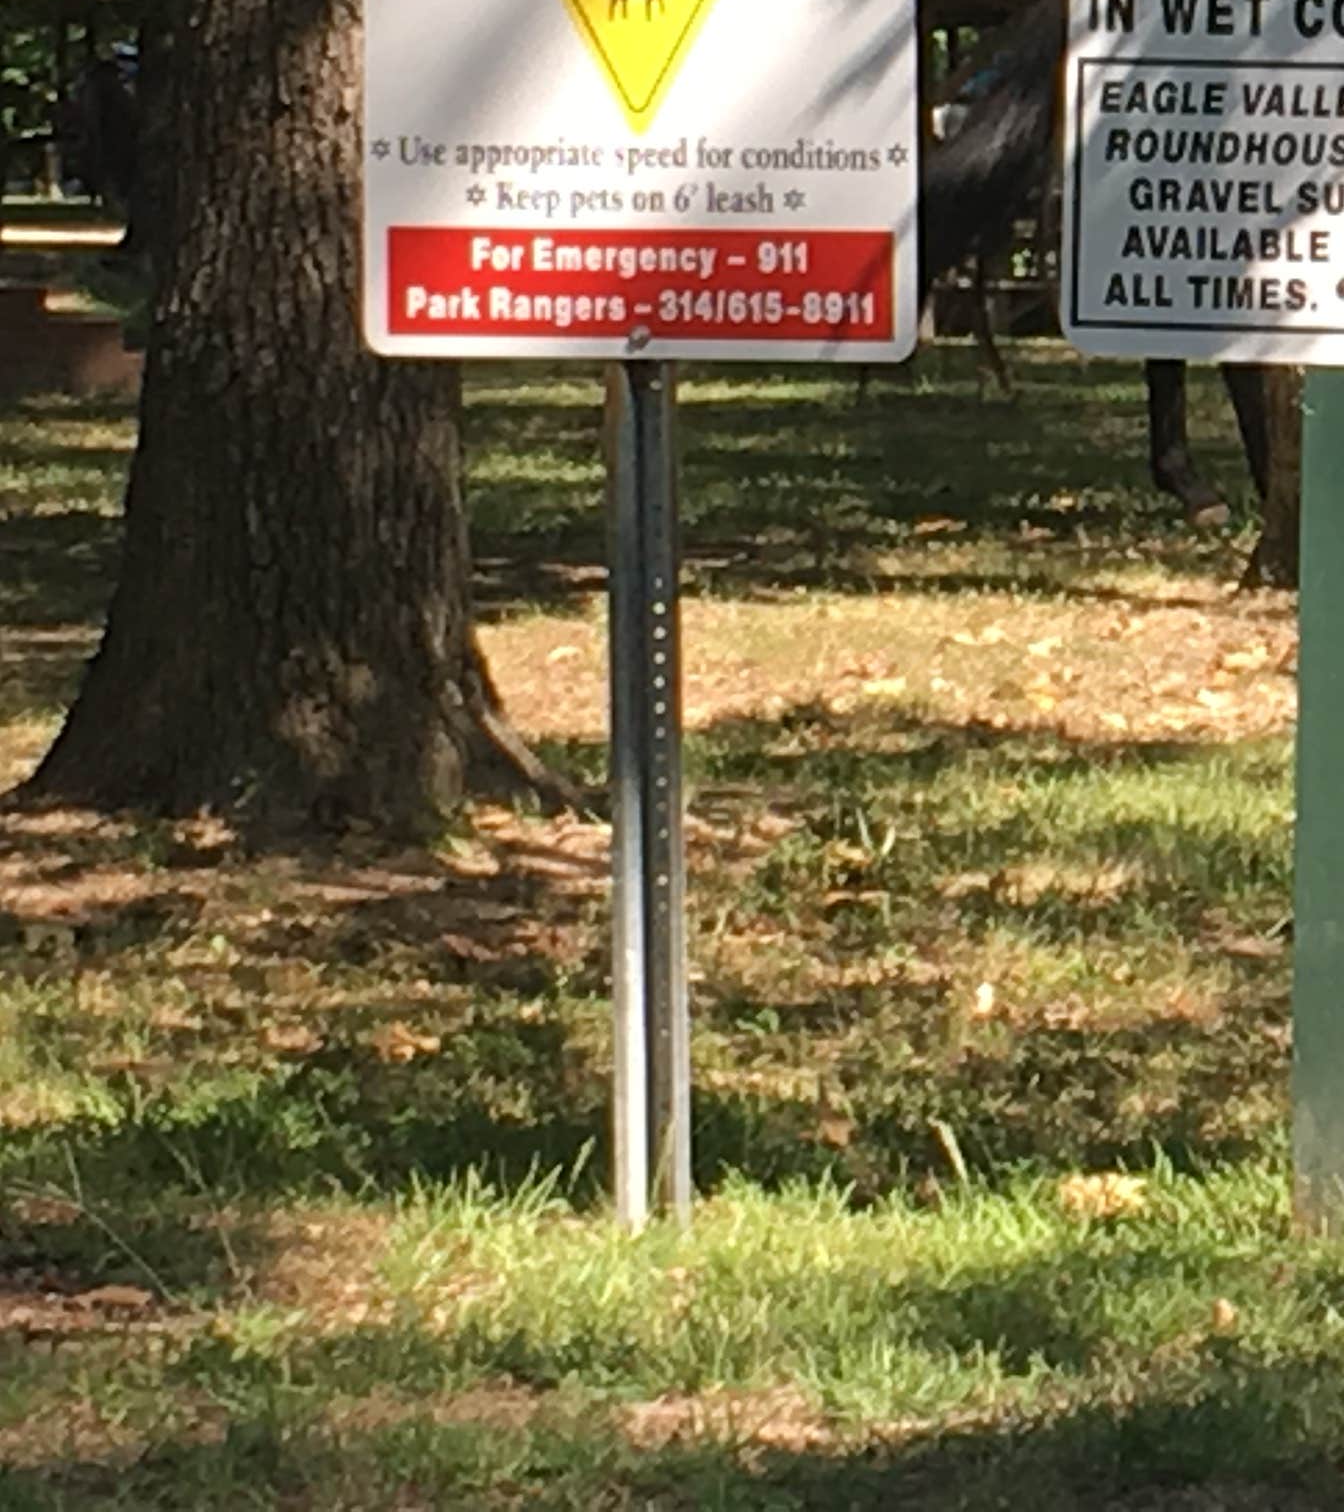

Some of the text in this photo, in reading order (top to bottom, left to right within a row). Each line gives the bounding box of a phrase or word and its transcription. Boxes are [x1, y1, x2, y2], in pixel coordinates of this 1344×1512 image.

[1100, 80, 1227, 115] EAGLE
[399, 136, 882, 173] Use appropriate speed for conditions
[496, 183, 560, 215] Keep
[570, 187, 624, 216] pets
[633, 191, 665, 213] on
[706, 184, 775, 213] leash
[1129, 179, 1282, 215] GRAVEL
[471, 237, 523, 271] For
[533, 238, 717, 279] Emergency
[757, 241, 808, 273] 911
[1121, 226, 1331, 264] AVAILABLE
[406, 286, 480, 321] Park
[490, 288, 626, 328] Rangers
[1103, 273, 1172, 307] ALL
[1187, 275, 1318, 312] TIMES.
